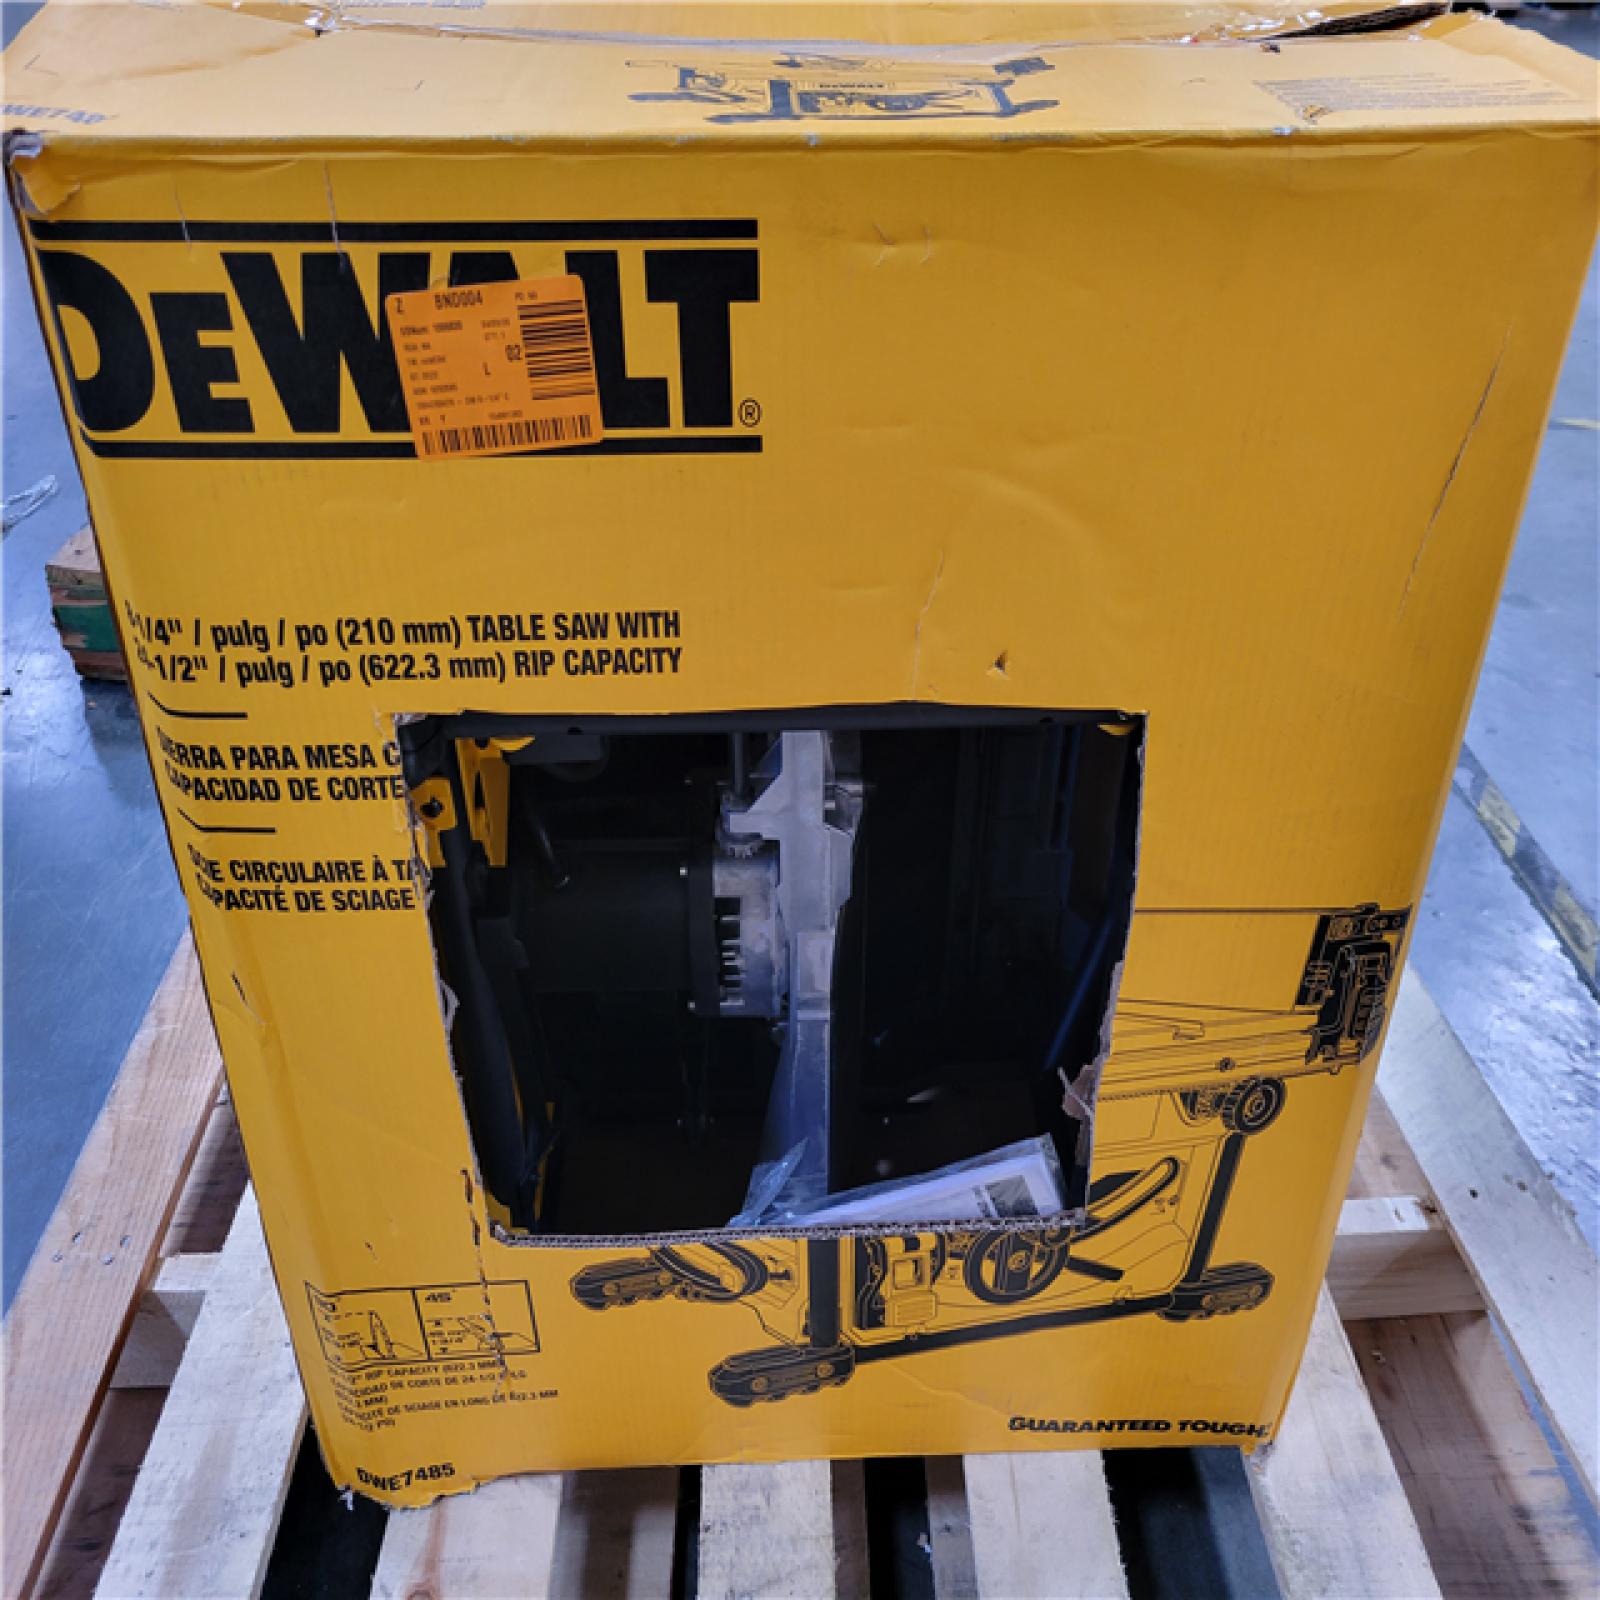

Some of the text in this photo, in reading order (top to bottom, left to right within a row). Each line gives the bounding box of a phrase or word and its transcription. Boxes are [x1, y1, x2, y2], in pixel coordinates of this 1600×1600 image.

[38, 248, 760, 433] DEWLT
[209, 619, 270, 652] pulg
[295, 624, 328, 652] po
[336, 617, 396, 650] (210
[402, 615, 461, 649] mm)
[466, 613, 546, 643] TABLE
[553, 611, 609, 641] SAW
[615, 610, 681, 639] WITH
[235, 655, 294, 688] pulg
[319, 660, 351, 688] po
[359, 652, 441, 687] (622.3
[449, 651, 506, 684] mm)
[513, 649, 556, 677] RIP
[563, 646, 683, 676] CAPACITY
[229, 745, 301, 771] PARA
[302, 743, 378, 769] MESA
[287, 776, 322, 802] DE
[326, 774, 404, 802] CORTE
[229, 858, 367, 884] CIRCULAIRE
[371, 854, 390, 882] À
[293, 888, 327, 913] DE
[331, 887, 417, 912] SCIAGE
[1009, 1416, 1172, 1433] GUARANTEED
